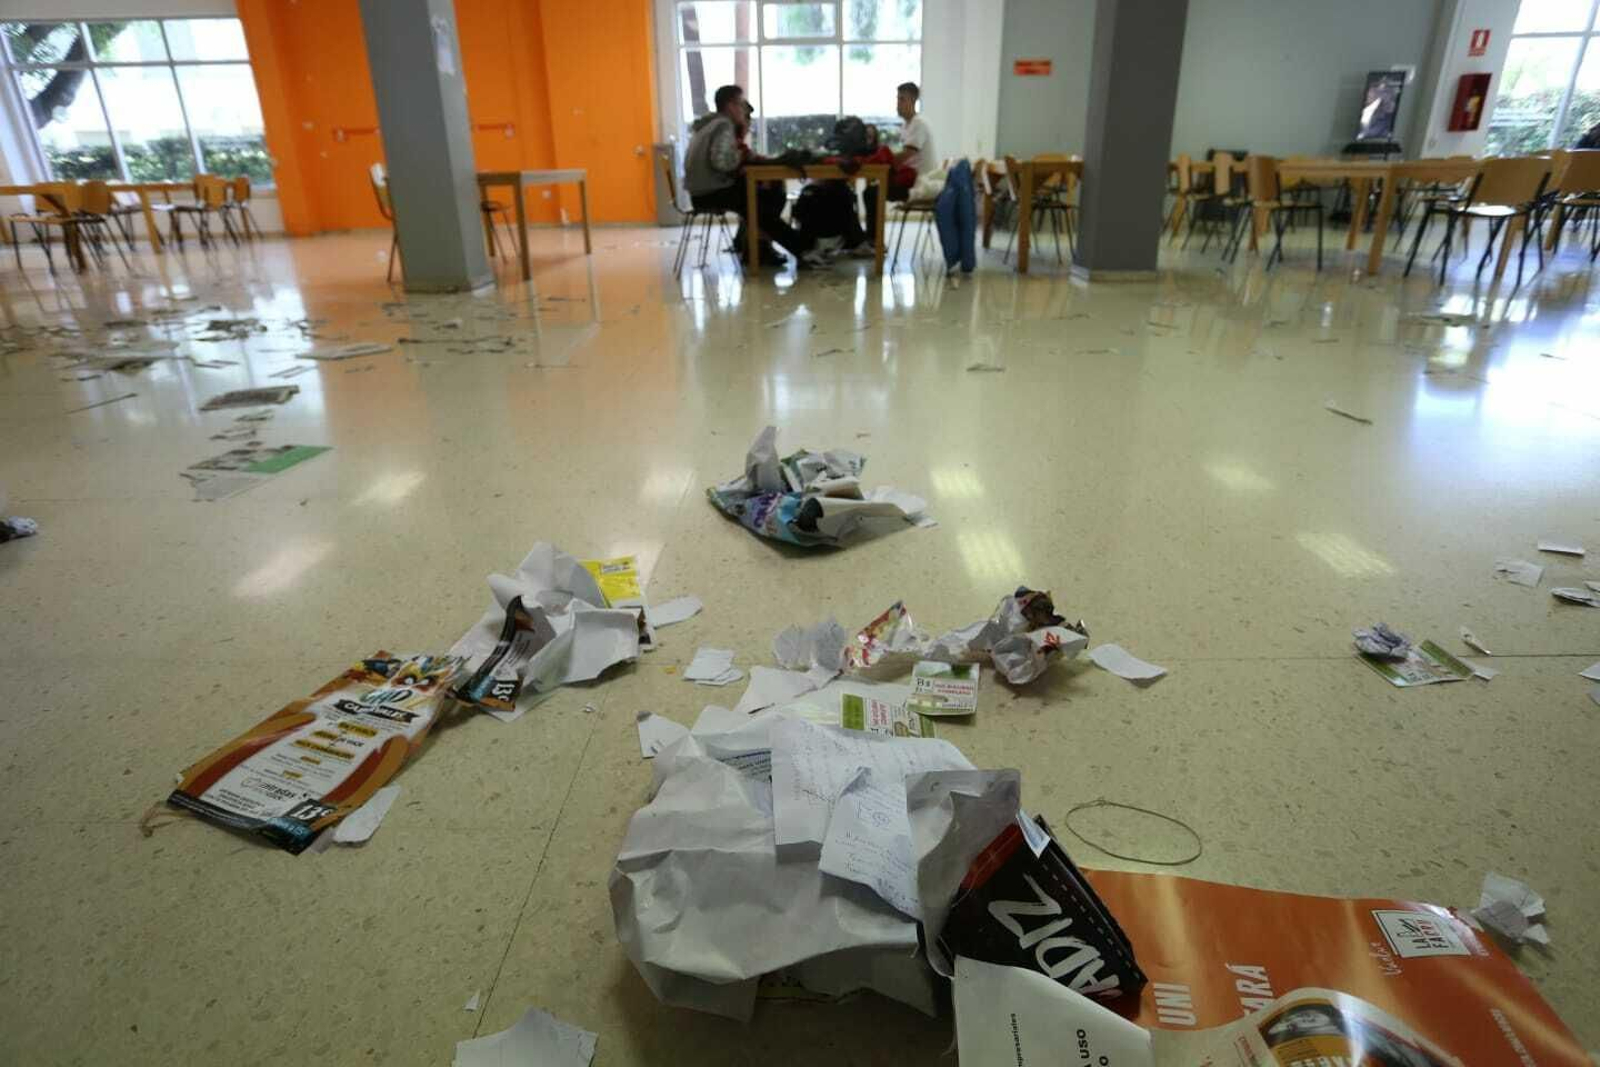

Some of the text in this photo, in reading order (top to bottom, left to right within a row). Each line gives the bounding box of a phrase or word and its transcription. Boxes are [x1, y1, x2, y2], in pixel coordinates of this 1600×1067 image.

[987, 872, 1123, 997] ADIZ
[1153, 982, 1197, 1026] UNI
[1076, 1028, 1091, 1059] USO
